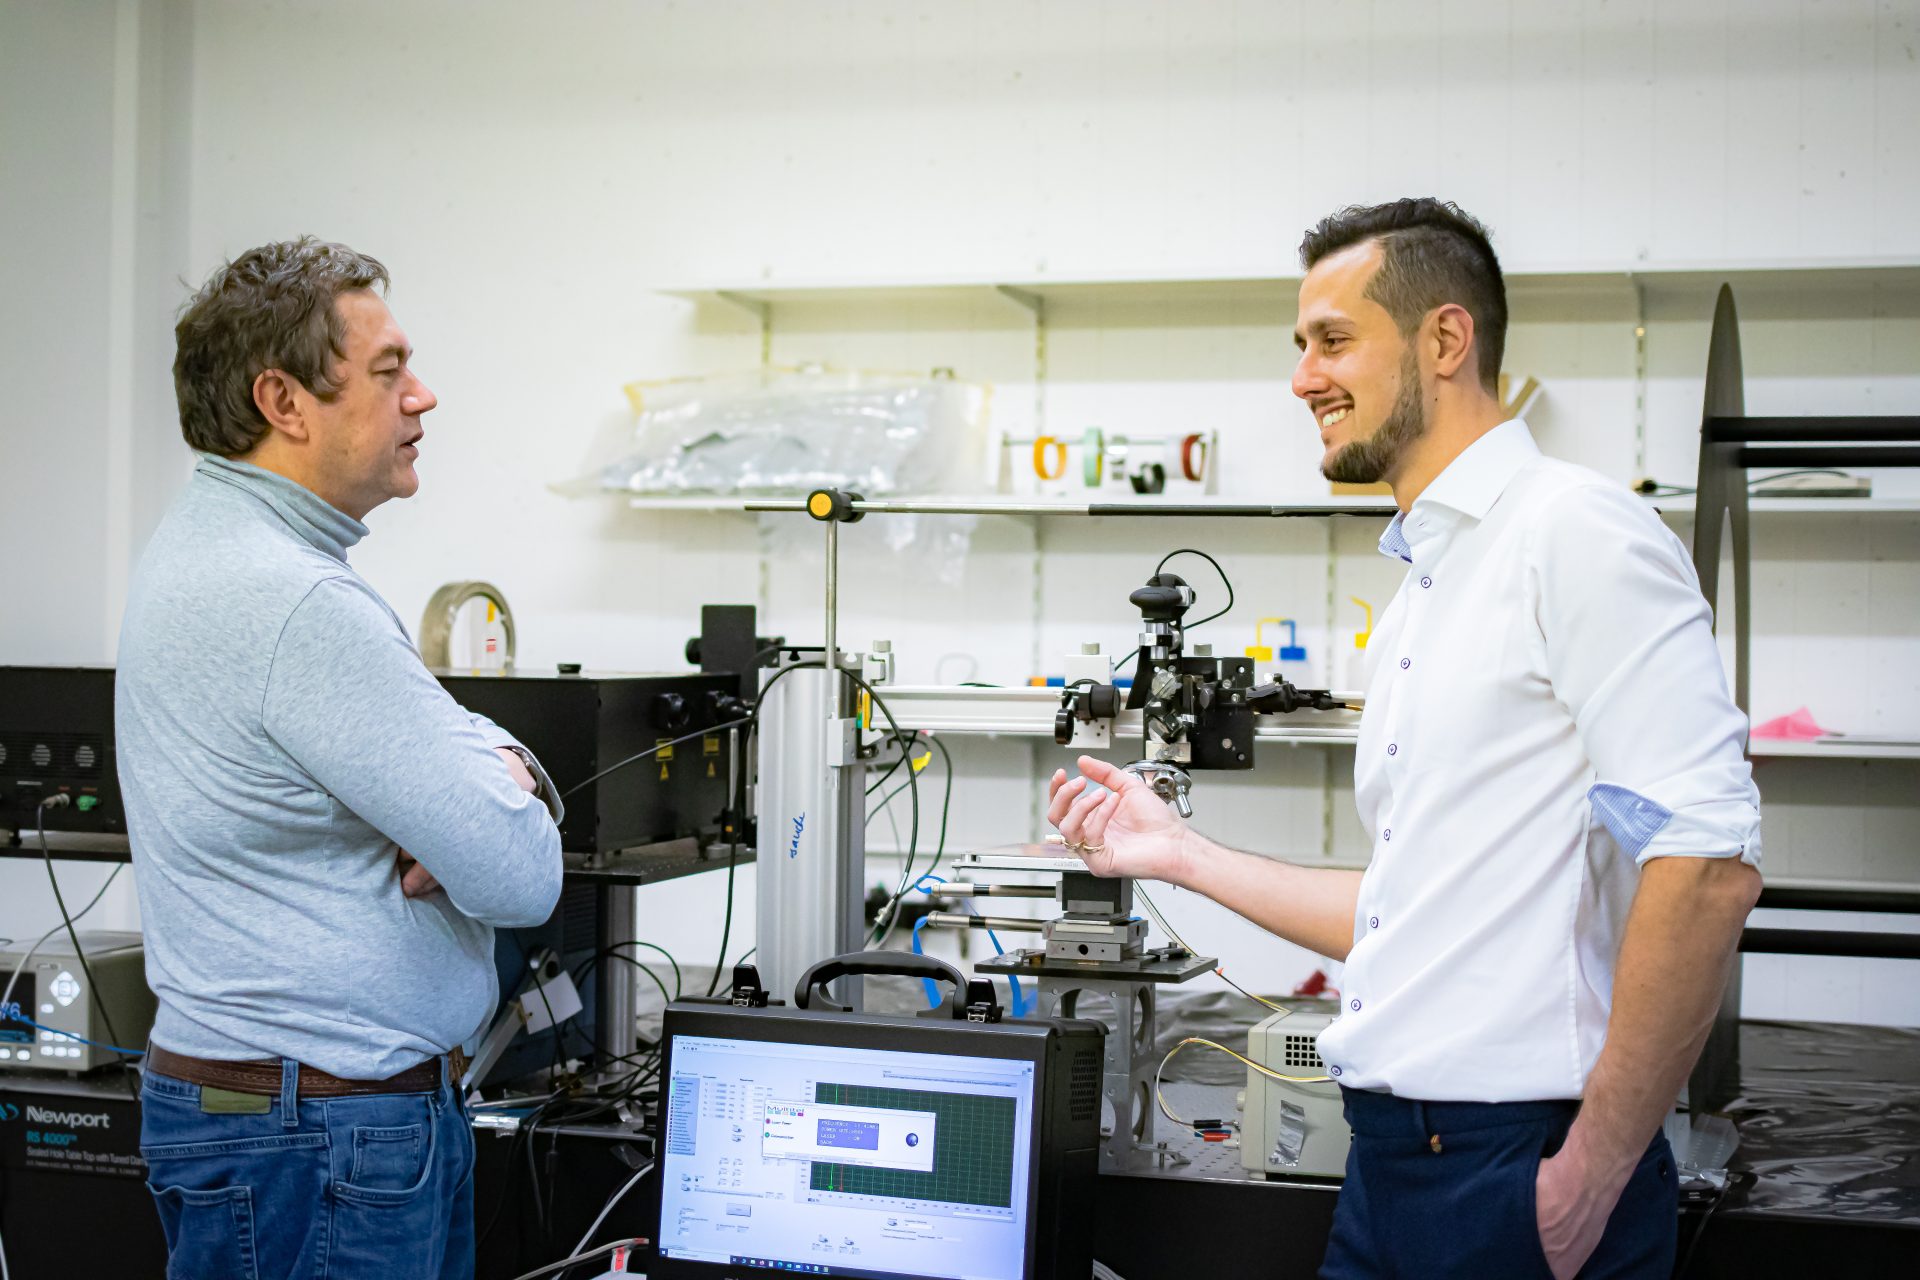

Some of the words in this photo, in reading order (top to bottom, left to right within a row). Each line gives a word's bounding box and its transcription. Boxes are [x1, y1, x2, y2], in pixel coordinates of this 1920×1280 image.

[26, 1105, 110, 1129] Newport
[26, 1130, 40, 1143] RS
[65, 1149, 82, 1161] Table
[83, 1150, 95, 1163] Top
